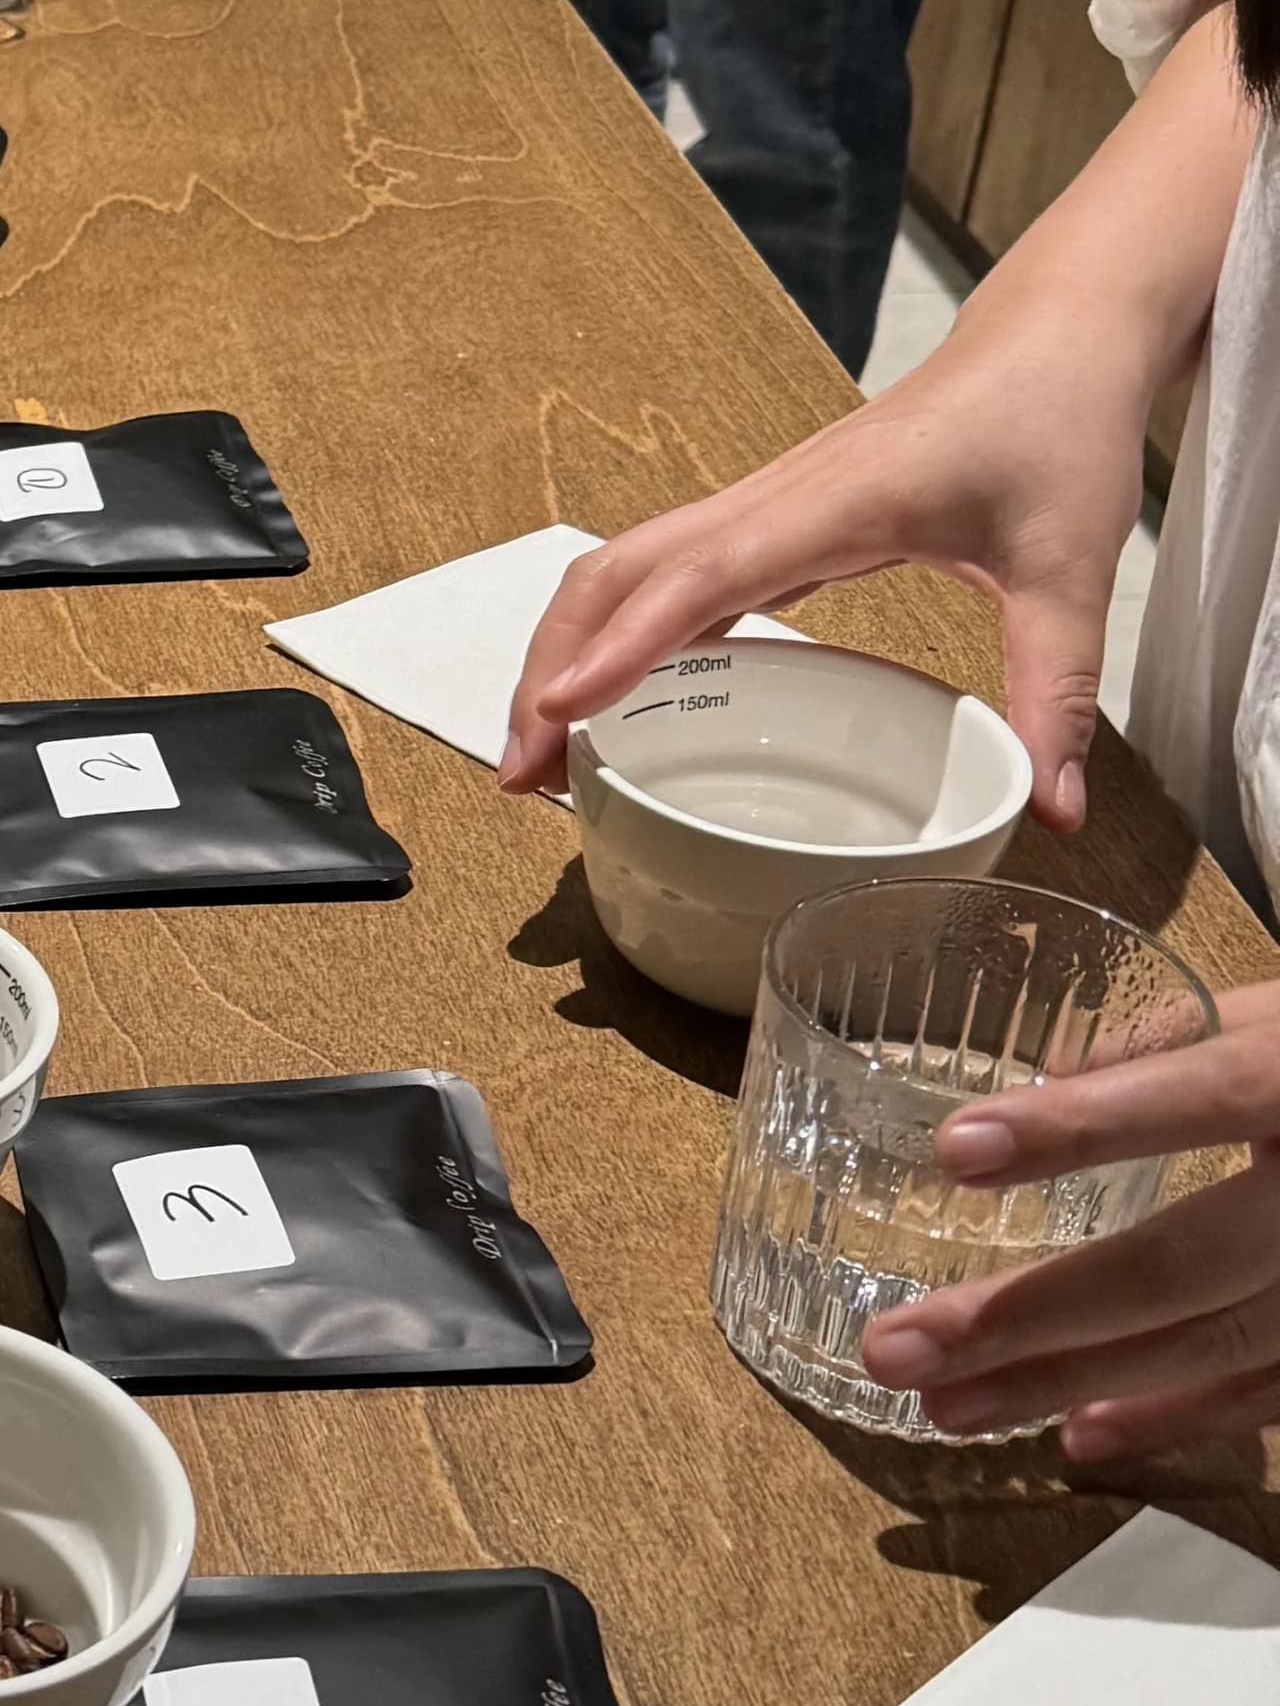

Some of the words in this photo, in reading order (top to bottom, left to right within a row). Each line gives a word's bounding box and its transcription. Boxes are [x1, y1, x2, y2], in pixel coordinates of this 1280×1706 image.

[677, 654, 732, 677] 200ml
[678, 691, 730, 712] 150ml
[8, 978, 32, 1022] 200ml
[162, 1183, 249, 1223] 3
[436, 1154, 481, 1211] Coffee
[470, 1213, 500, 1261] Drip
